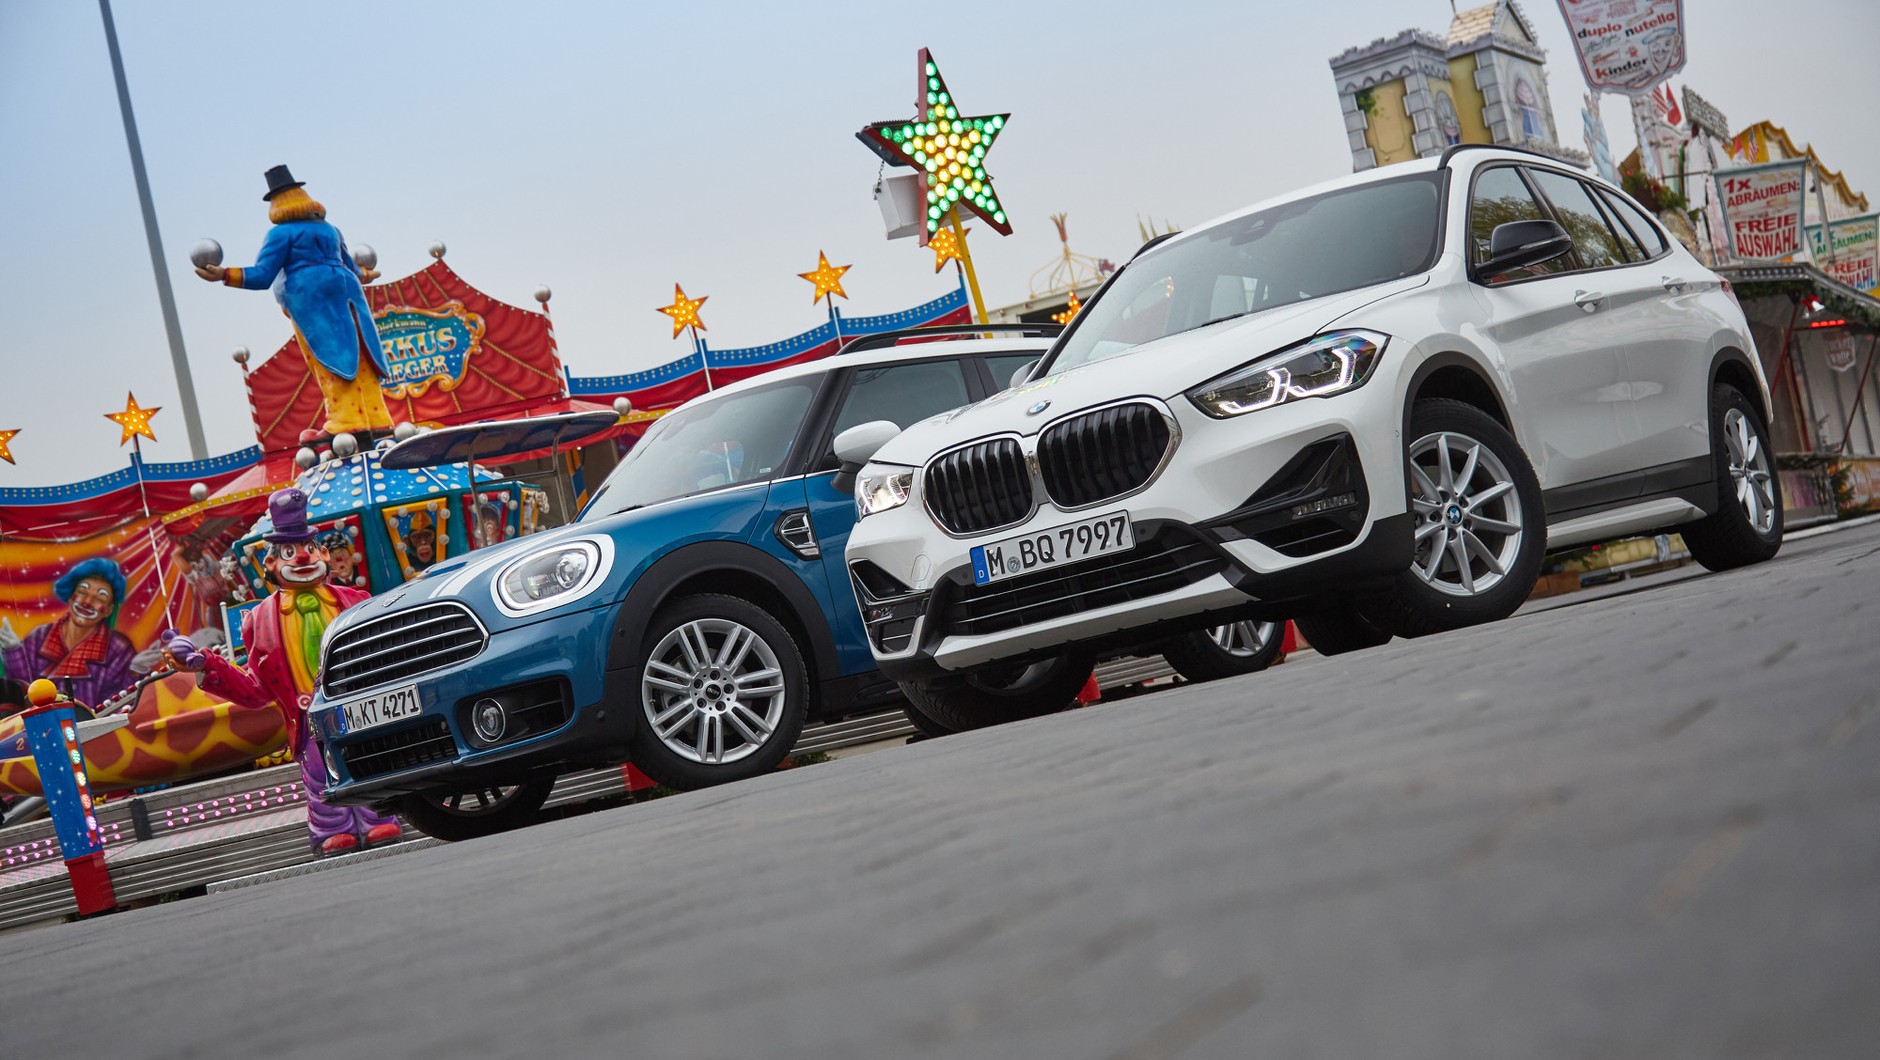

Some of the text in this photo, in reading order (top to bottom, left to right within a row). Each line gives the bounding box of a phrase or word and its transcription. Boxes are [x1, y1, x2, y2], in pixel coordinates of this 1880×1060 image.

[1577, 23, 1622, 39] duplo
[1625, 12, 1676, 37] nutella
[1595, 58, 1648, 79] kinder
[1727, 180, 1800, 208] ABRÄUMEN:
[1735, 213, 1797, 233] FREIE
[1736, 227, 1799, 257] AUSWAHL
[381, 327, 457, 362] RKUS
[381, 355, 449, 384] IEGER
[986, 546, 1006, 577] M
[1019, 534, 1056, 569] BQ
[1058, 515, 1126, 559] 7997
[344, 706, 356, 730] M
[360, 699, 378, 726] KT
[382, 689, 420, 719] 4271
[16, 738, 24, 751] 2
